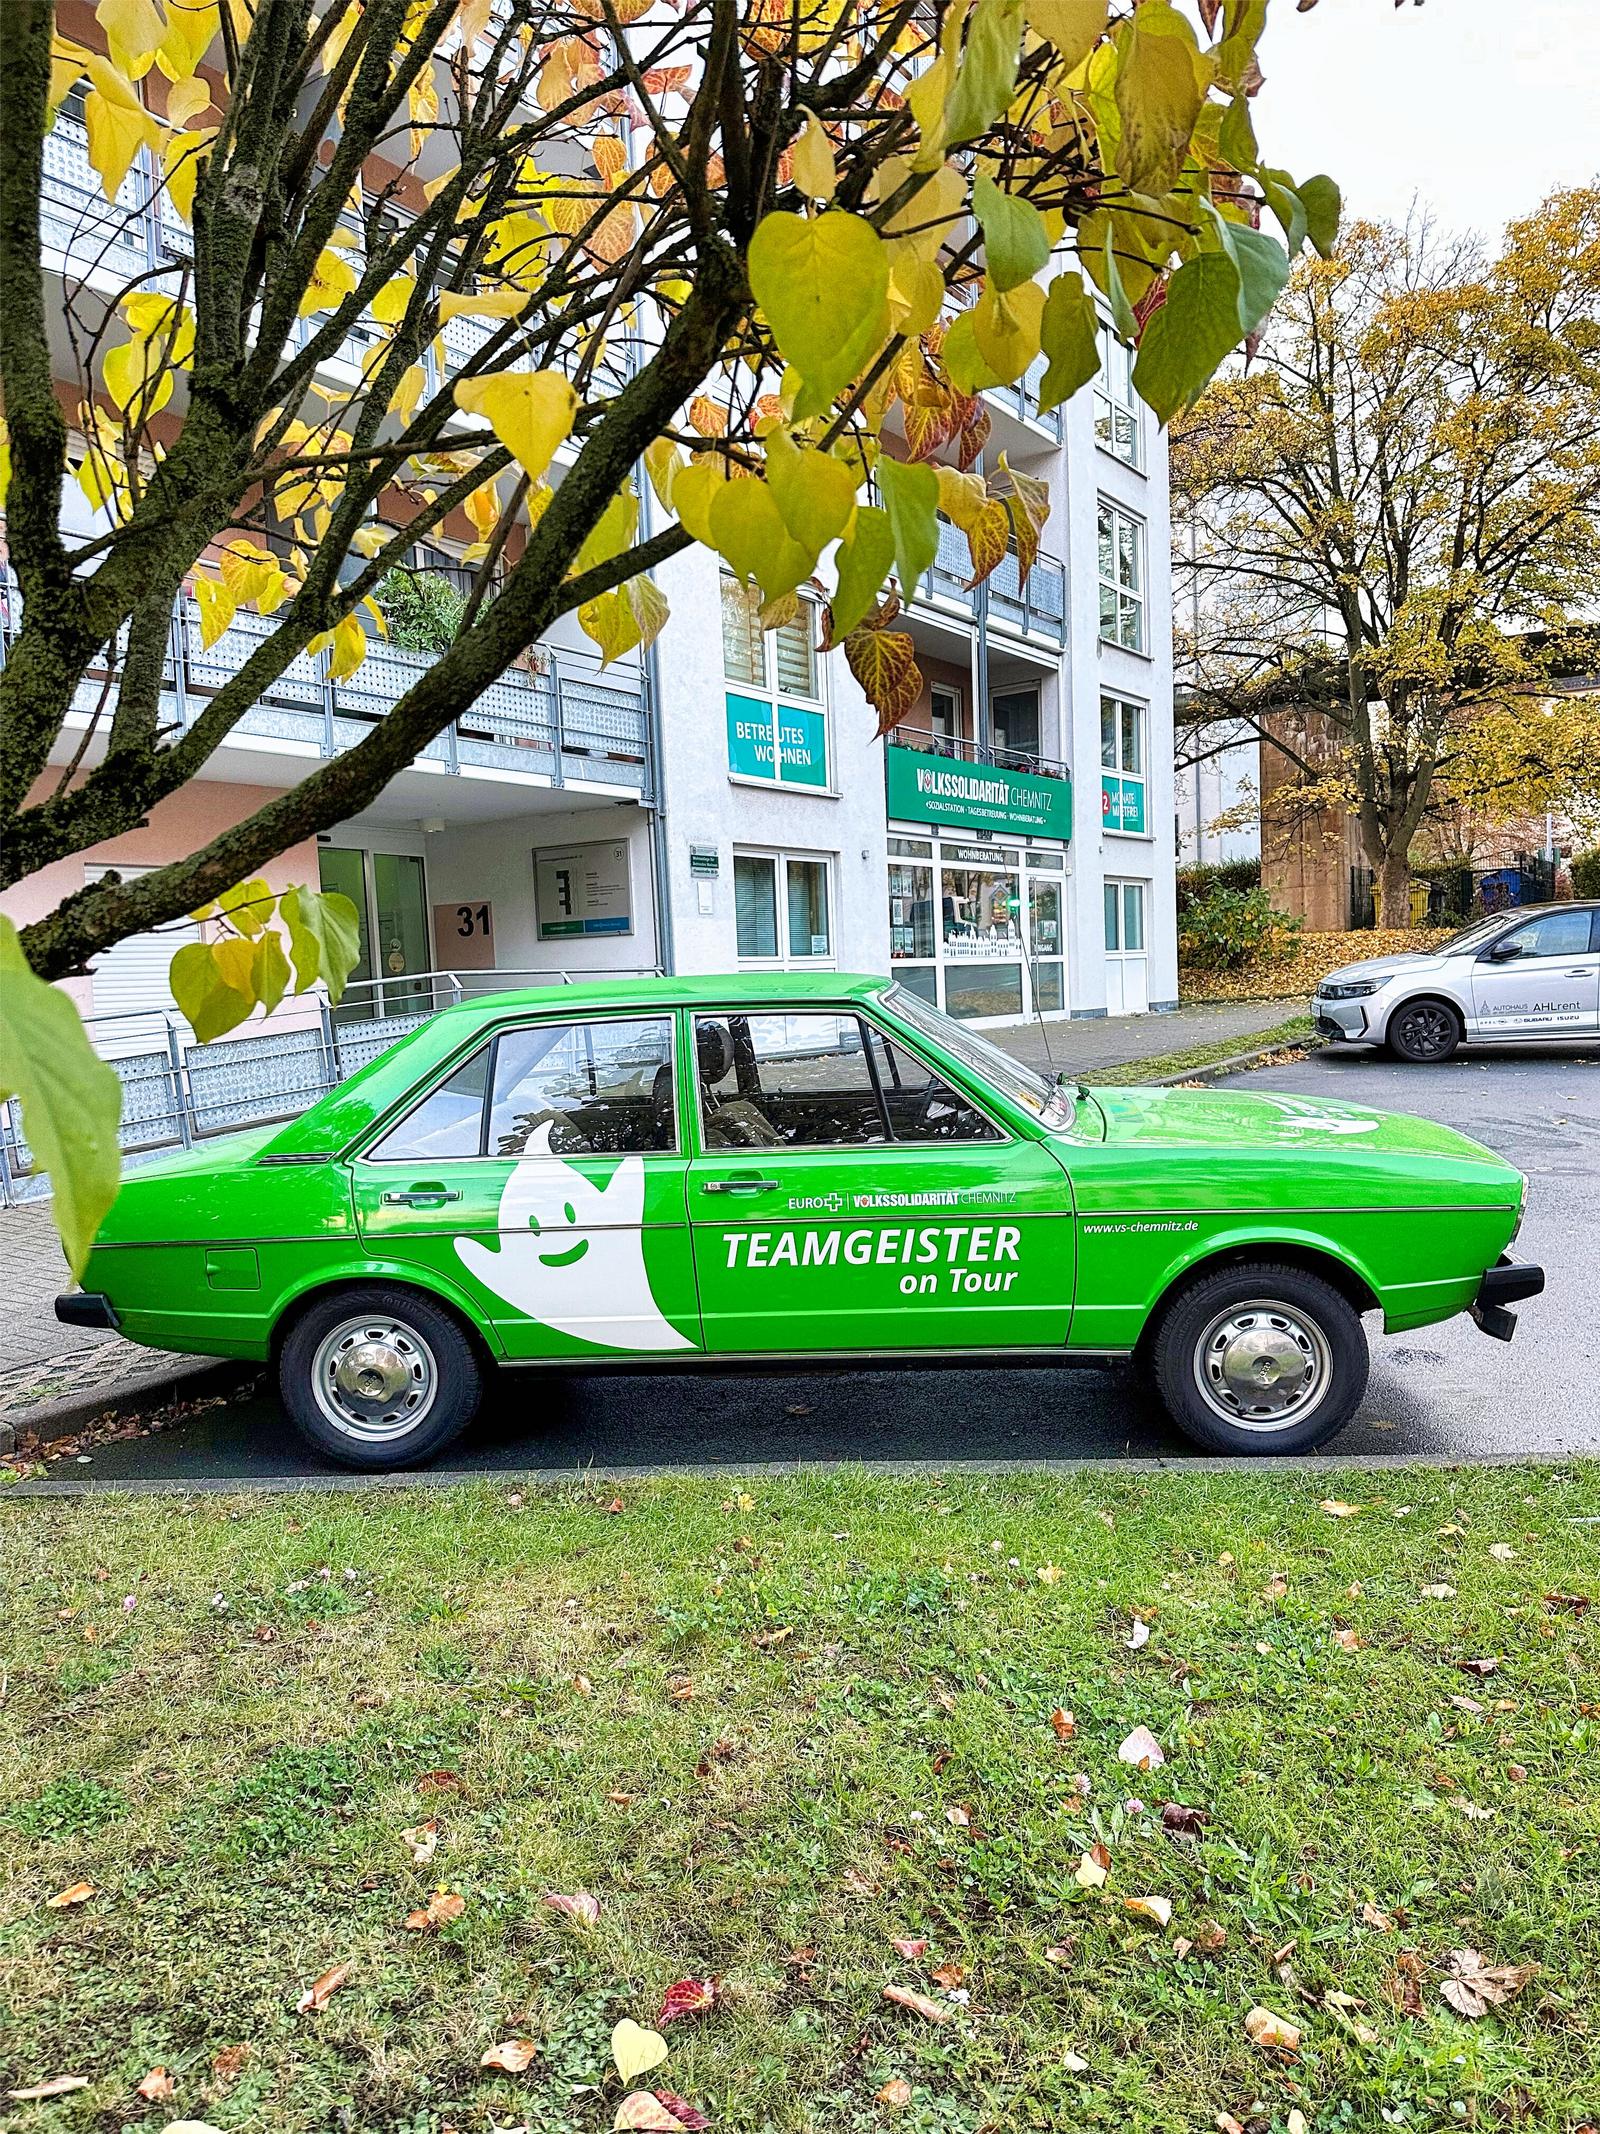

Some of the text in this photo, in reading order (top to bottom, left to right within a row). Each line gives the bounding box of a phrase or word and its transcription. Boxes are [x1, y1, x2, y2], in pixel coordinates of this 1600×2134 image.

[735, 721, 804, 745] BETREUTES
[753, 744, 812, 766] WOHNEN
[916, 767, 1052, 811] VOLKSSOLIDARITÄT CHEMNITZ
[957, 849, 1004, 863] WOHNBERATUNG
[456, 904, 490, 937] 31
[1492, 1003, 1529, 1012] AUTOHAUS
[1532, 1000, 1581, 1013] AHLrent
[788, 1191, 1017, 1210] EURO VOLKSSOLIDARITÄT CHEMNITZ
[1083, 1220, 1199, 1234] www.vs-chemnitz.de
[722, 1226, 1021, 1268] TEAMGEISTER
[900, 1268, 1018, 1294] on Tour
